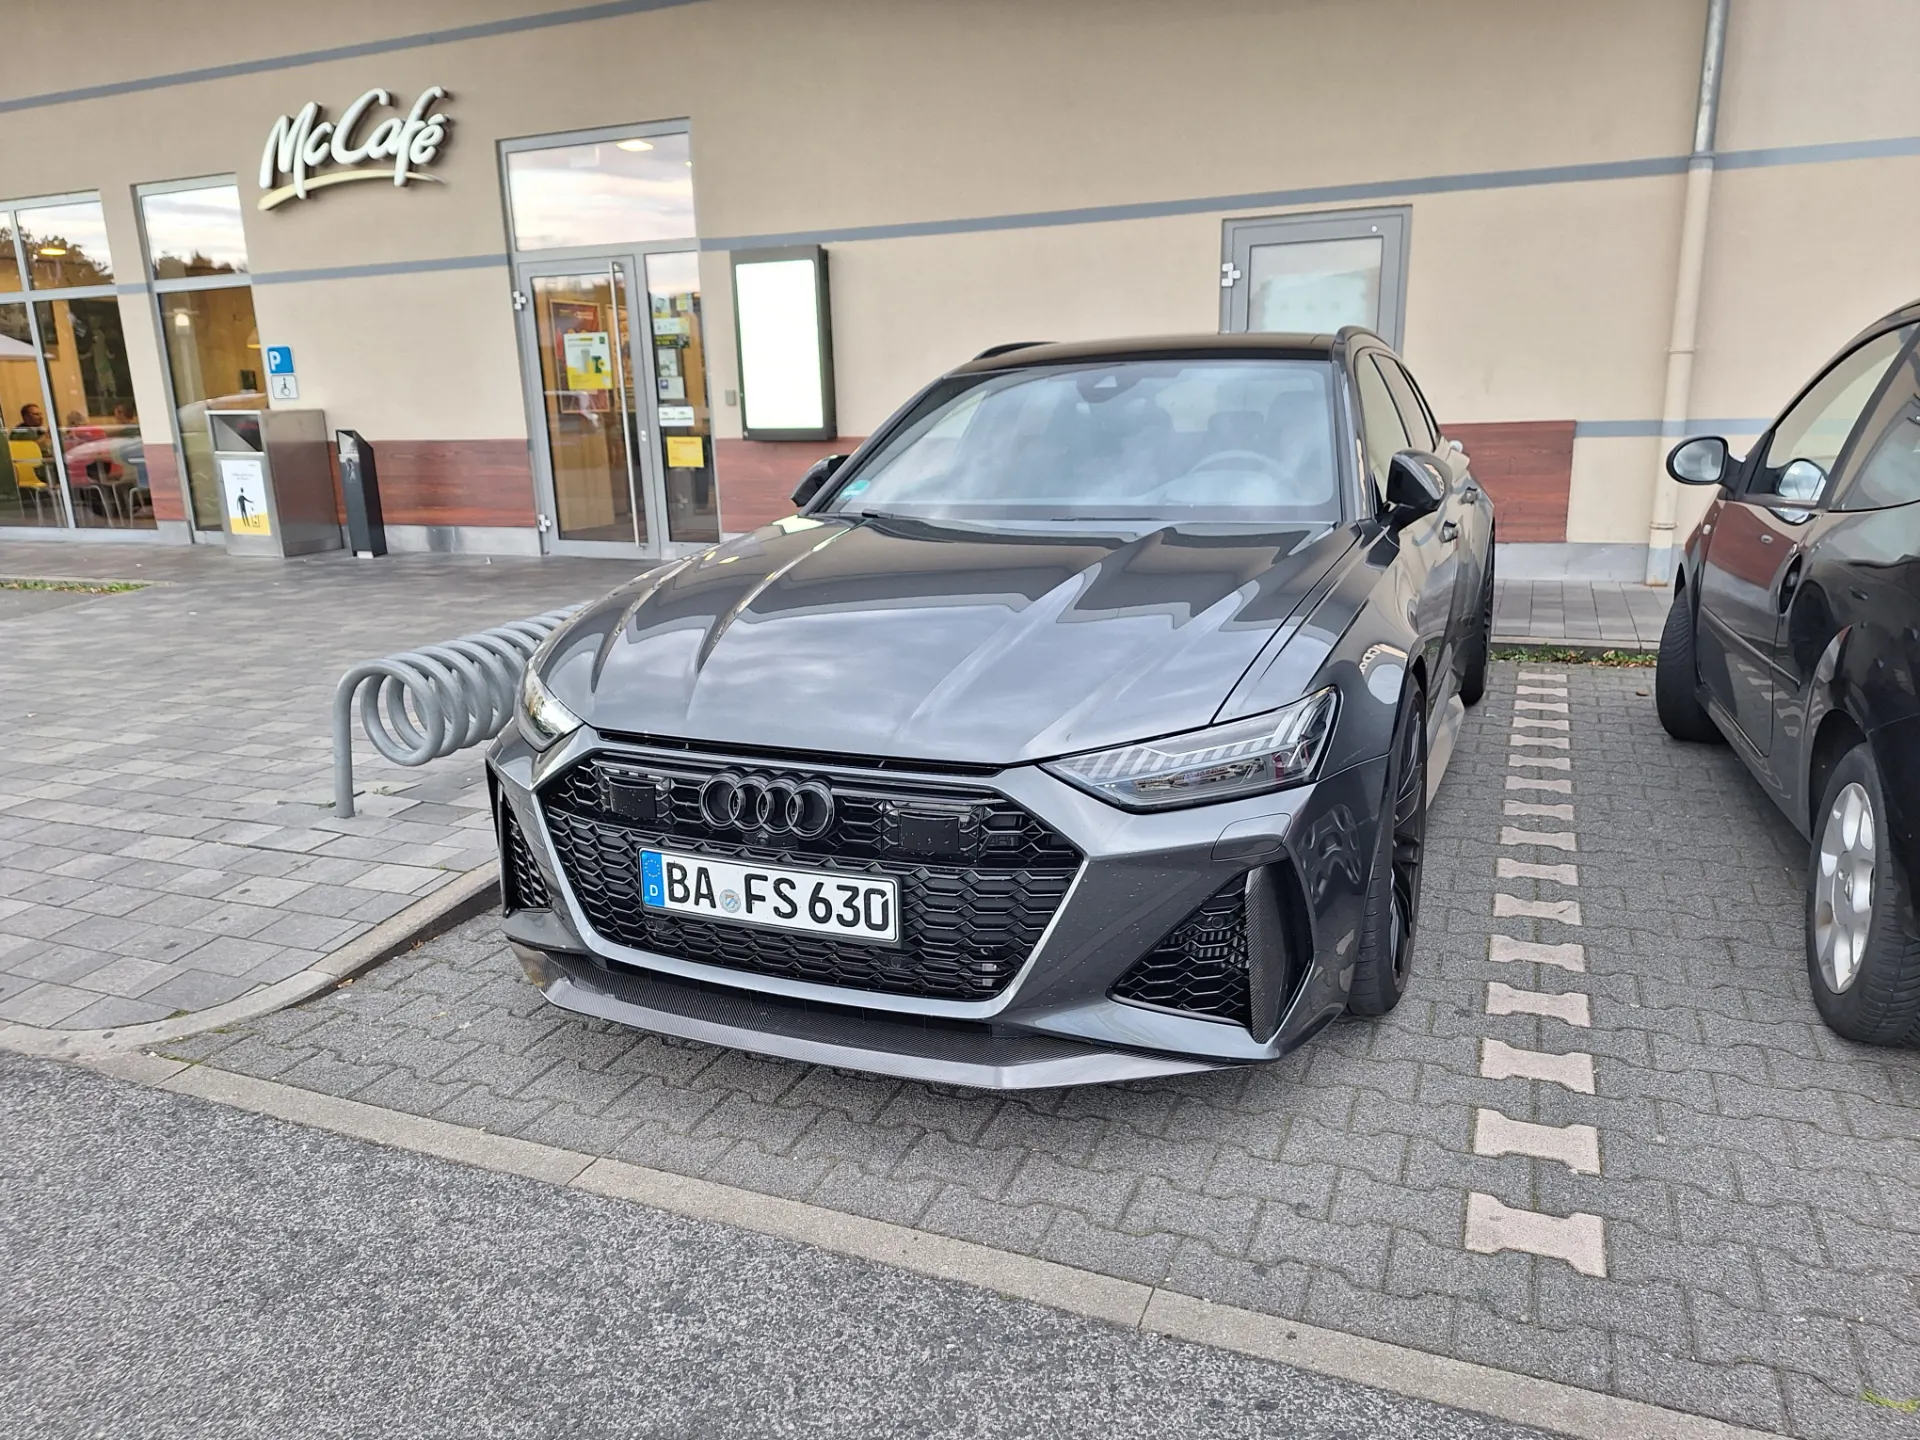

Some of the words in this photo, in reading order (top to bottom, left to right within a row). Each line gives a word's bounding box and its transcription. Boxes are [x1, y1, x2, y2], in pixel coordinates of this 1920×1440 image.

[259, 86, 447, 199] McCafé
[269, 351, 281, 371] P
[650, 884, 659, 897] D
[666, 861, 717, 908] BA
[744, 873, 798, 919] FS
[808, 882, 889, 931] 630
